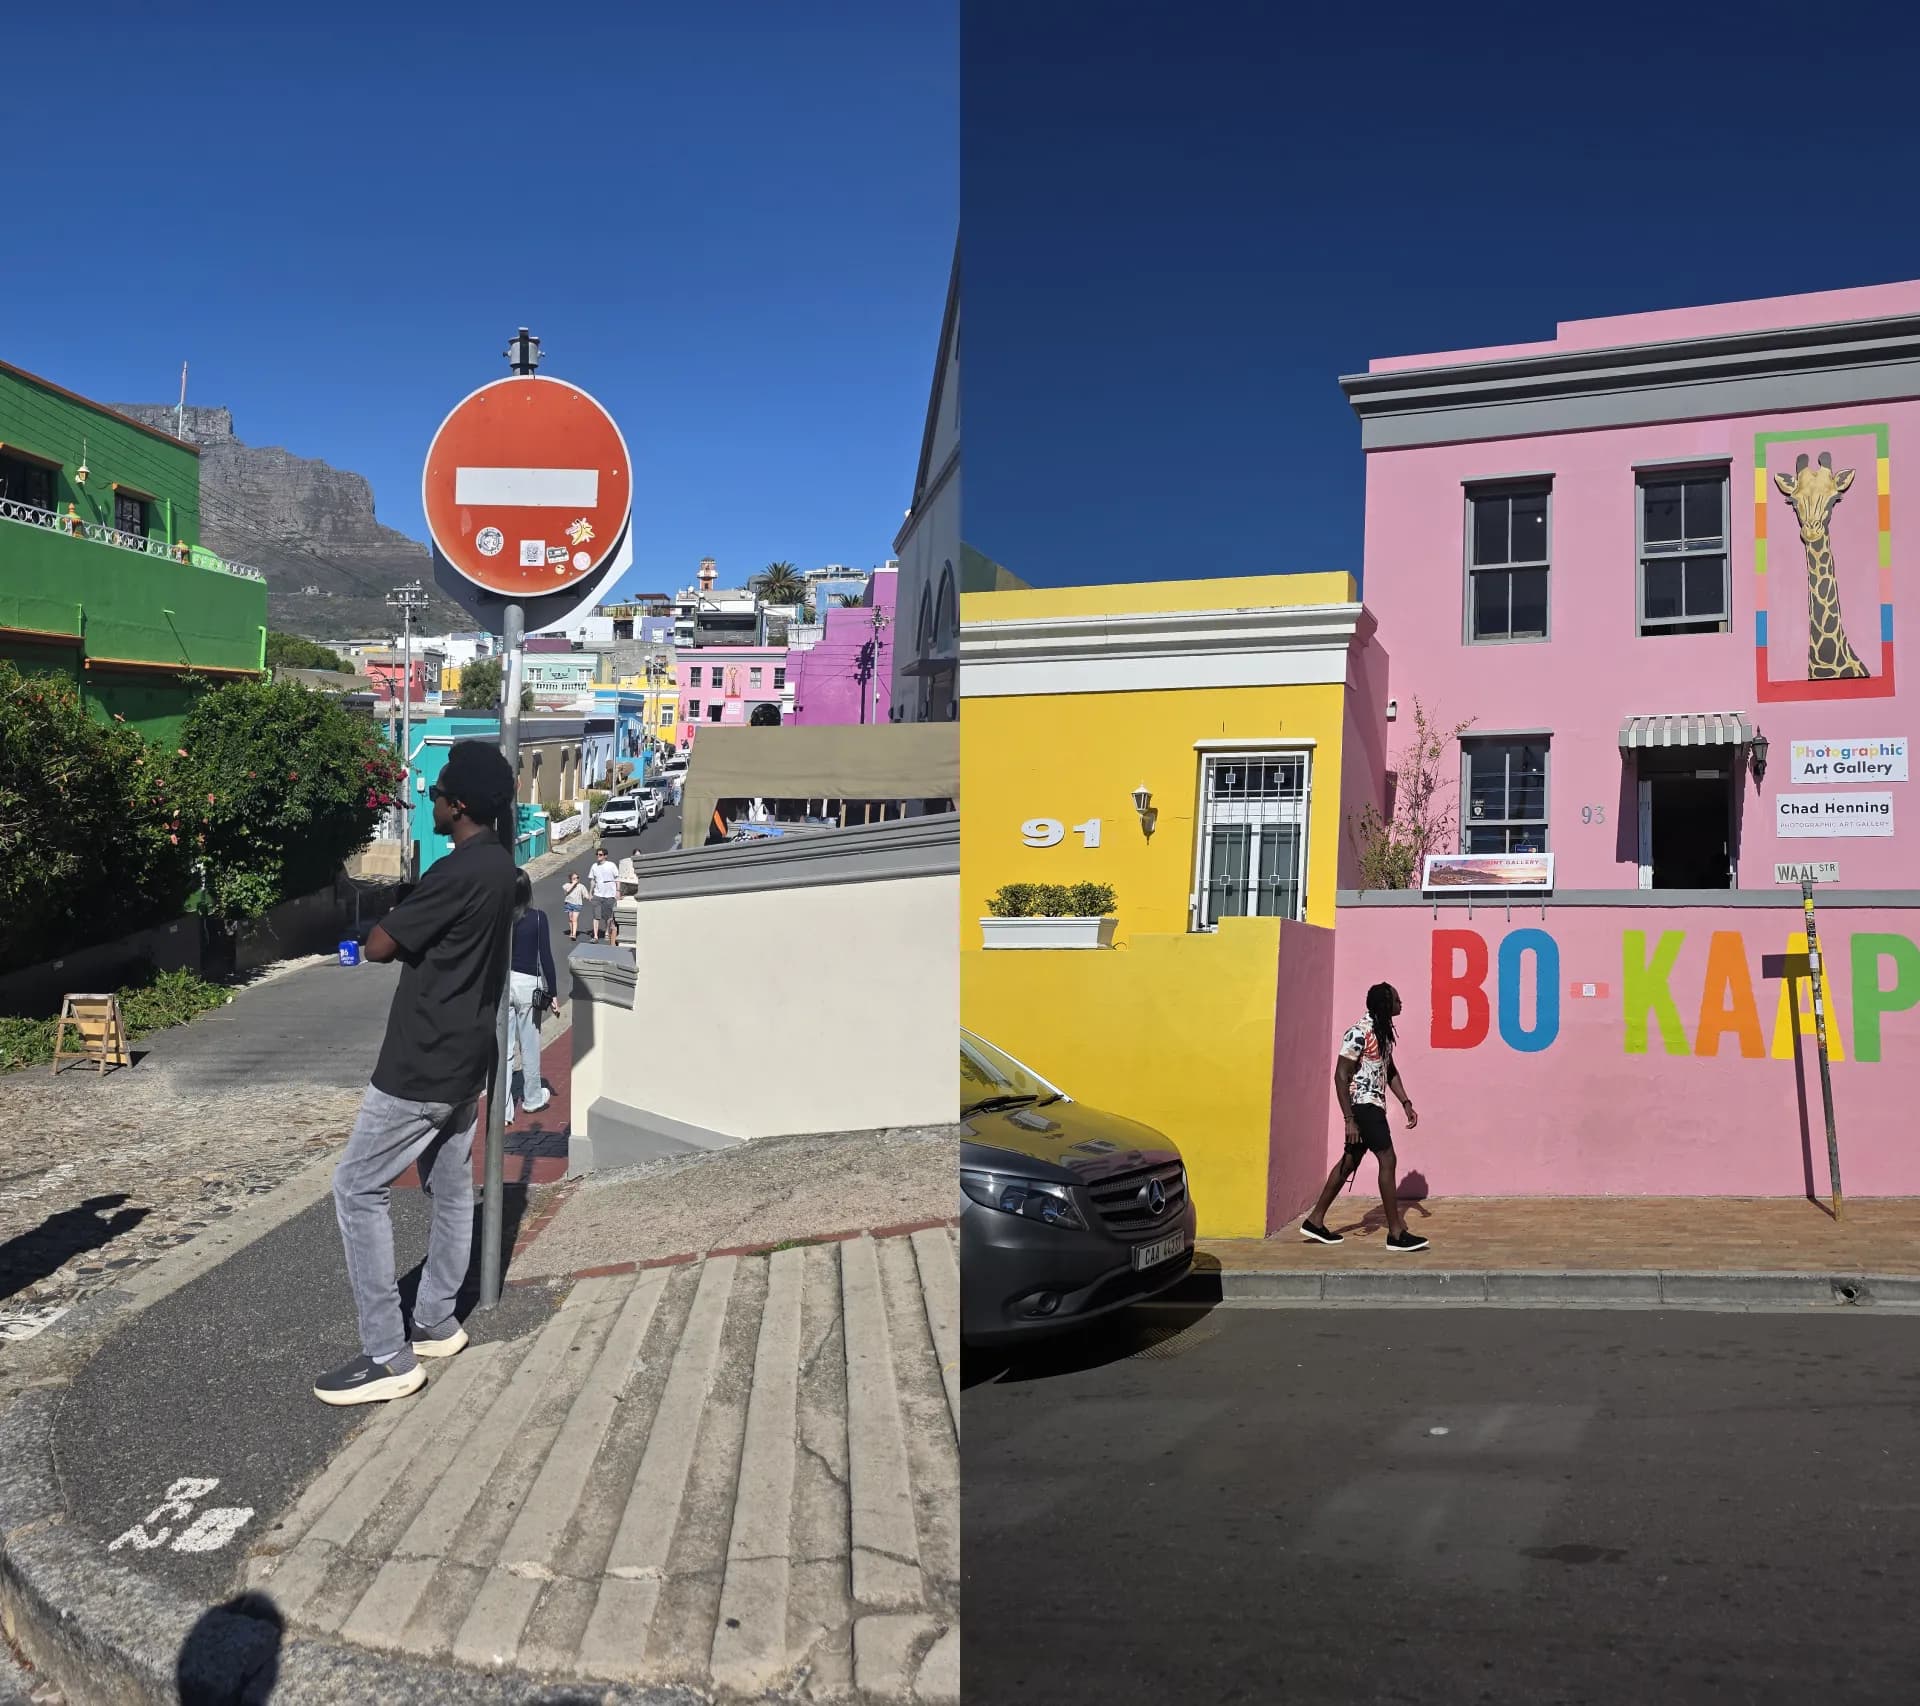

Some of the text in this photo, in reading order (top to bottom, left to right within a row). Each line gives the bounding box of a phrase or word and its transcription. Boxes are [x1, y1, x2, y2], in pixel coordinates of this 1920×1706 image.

[1795, 744, 1903, 760] Photographic
[1804, 761, 1893, 776] Art Gallery
[1582, 806, 1606, 825] 93
[1780, 802, 1889, 815] Chad Henning
[1021, 818, 1101, 848] 91
[1778, 864, 1836, 881] WAAL STR
[1145, 1245, 1160, 1266] CAA
